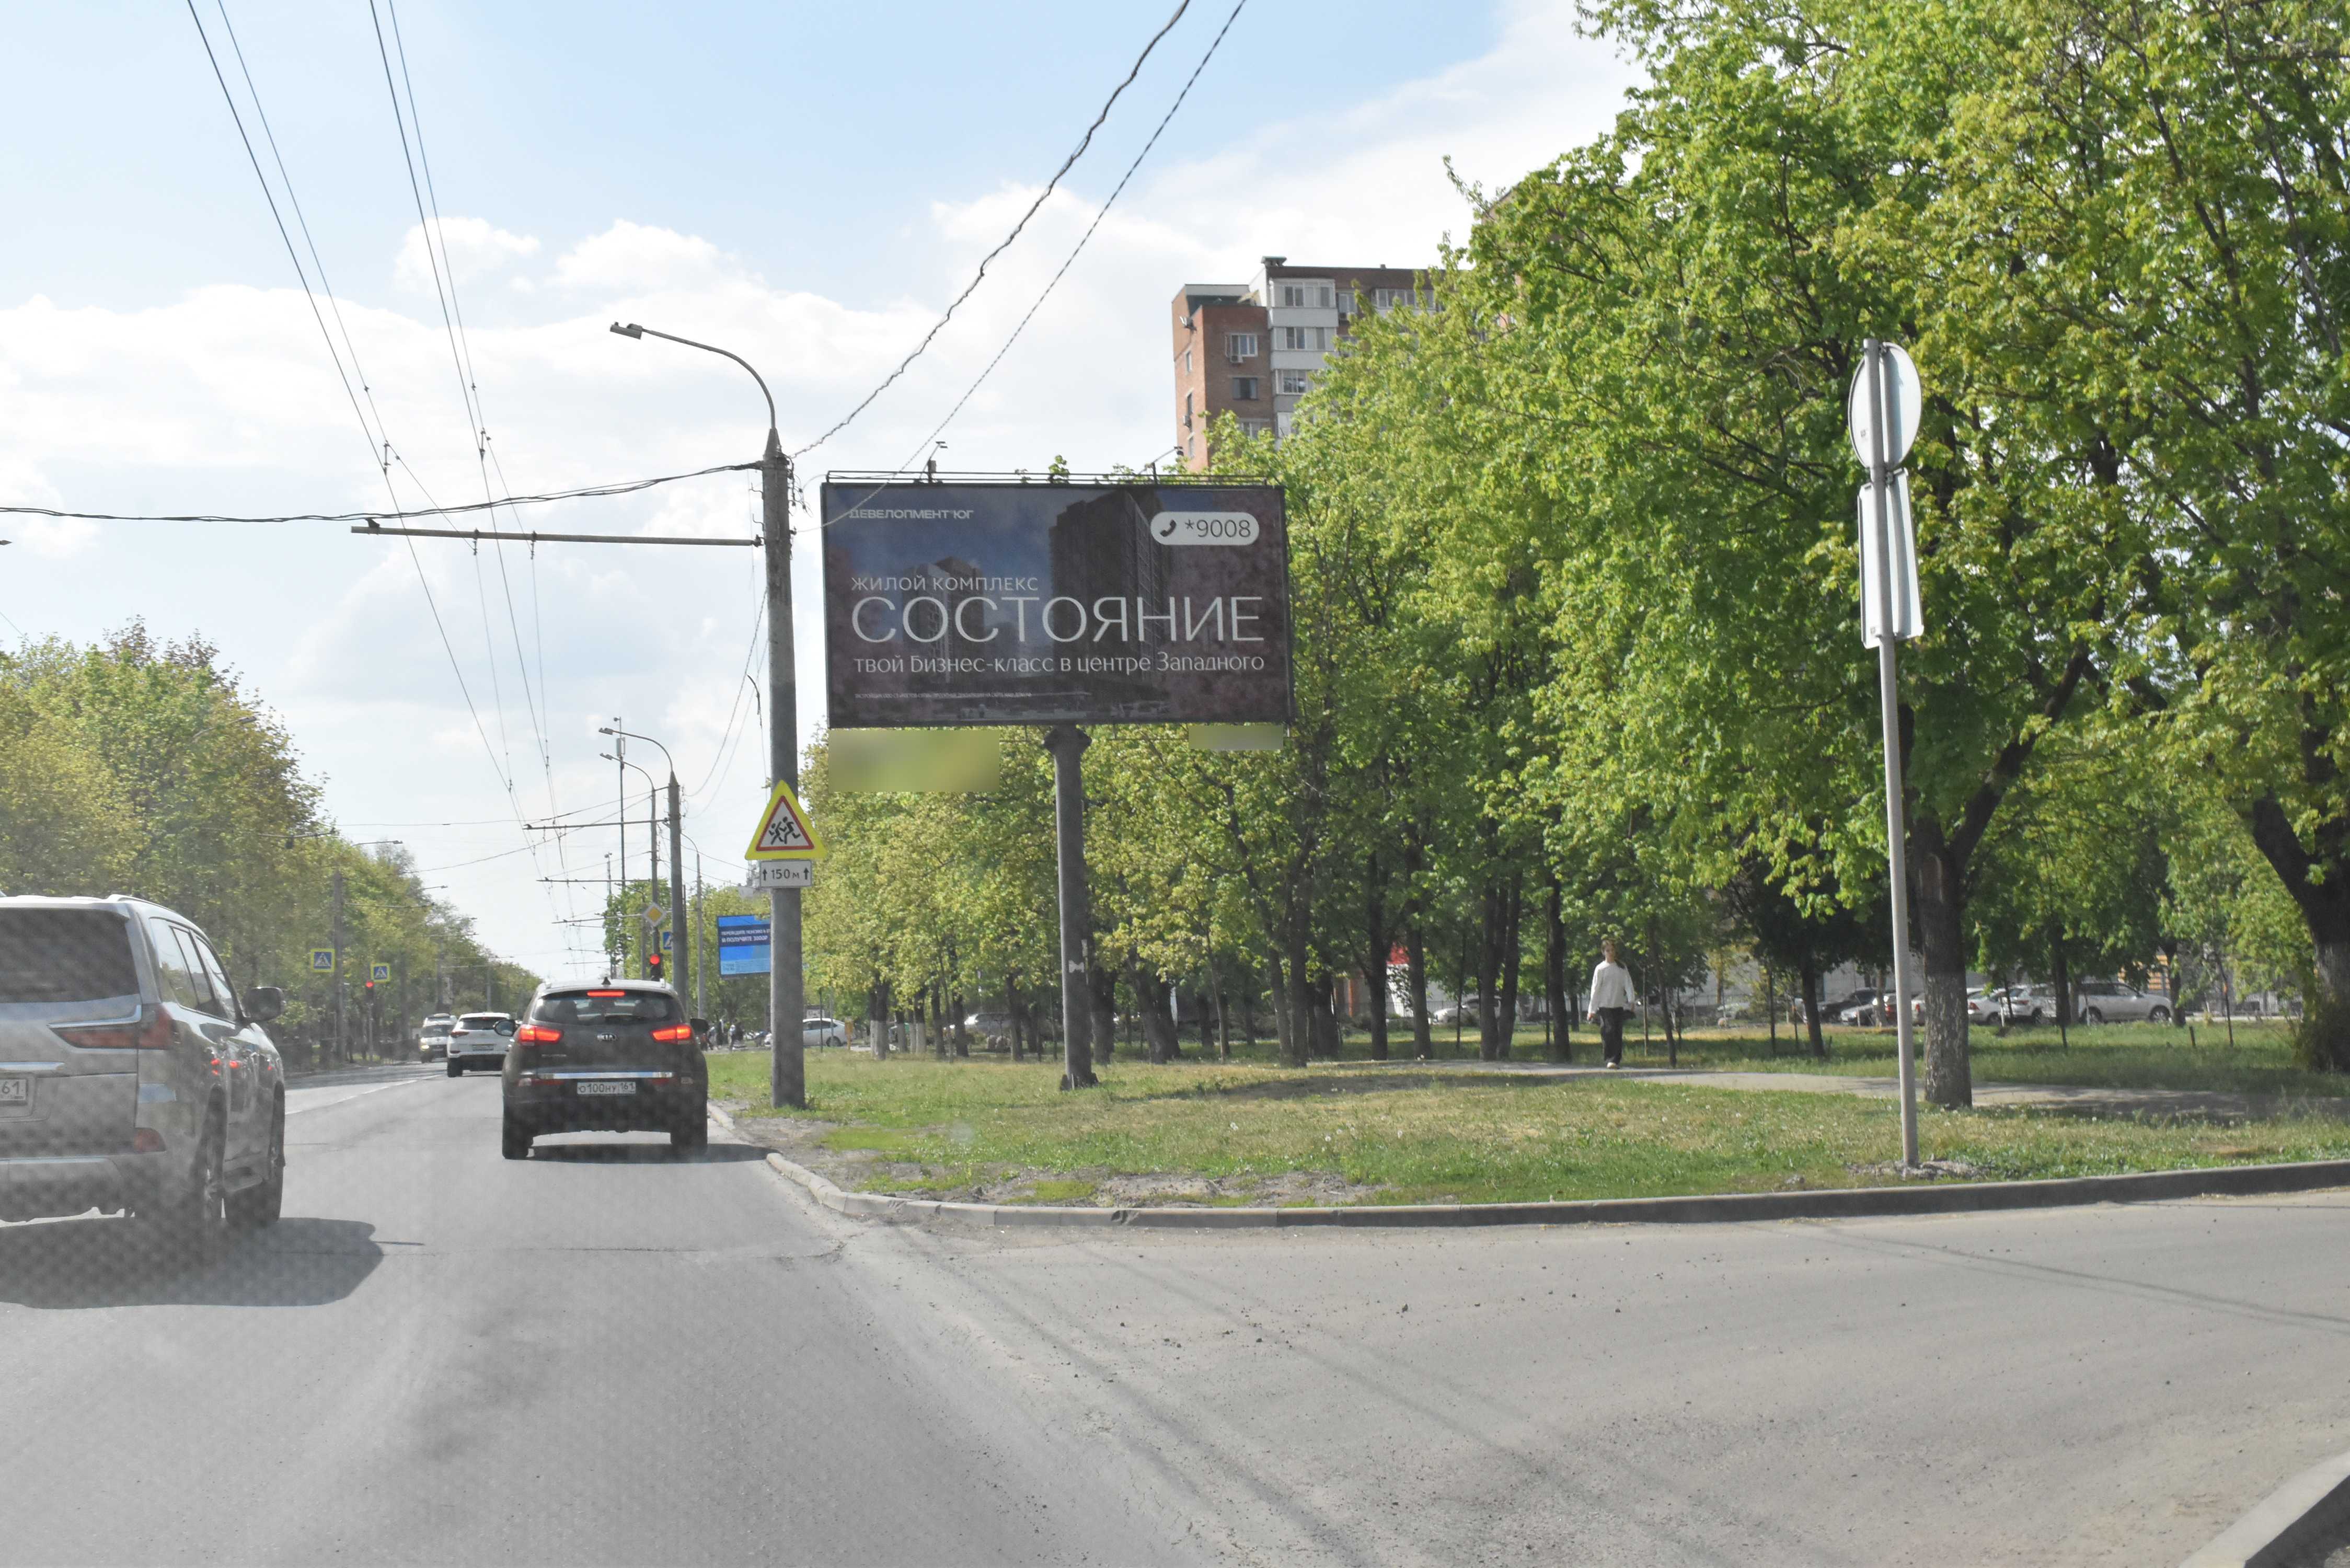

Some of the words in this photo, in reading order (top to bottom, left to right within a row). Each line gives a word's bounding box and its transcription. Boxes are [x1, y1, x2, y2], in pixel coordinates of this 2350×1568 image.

[851, 574, 926, 591] ЖИЛОЙ
[933, 577, 1038, 591] КОМПЛЕКС
[852, 596, 1264, 642] СОСТОЯНИЕ
[1061, 658, 1071, 671] в
[1078, 657, 1150, 676] центре
[1157, 651, 1264, 671] Западного
[771, 869, 790, 879] 150
